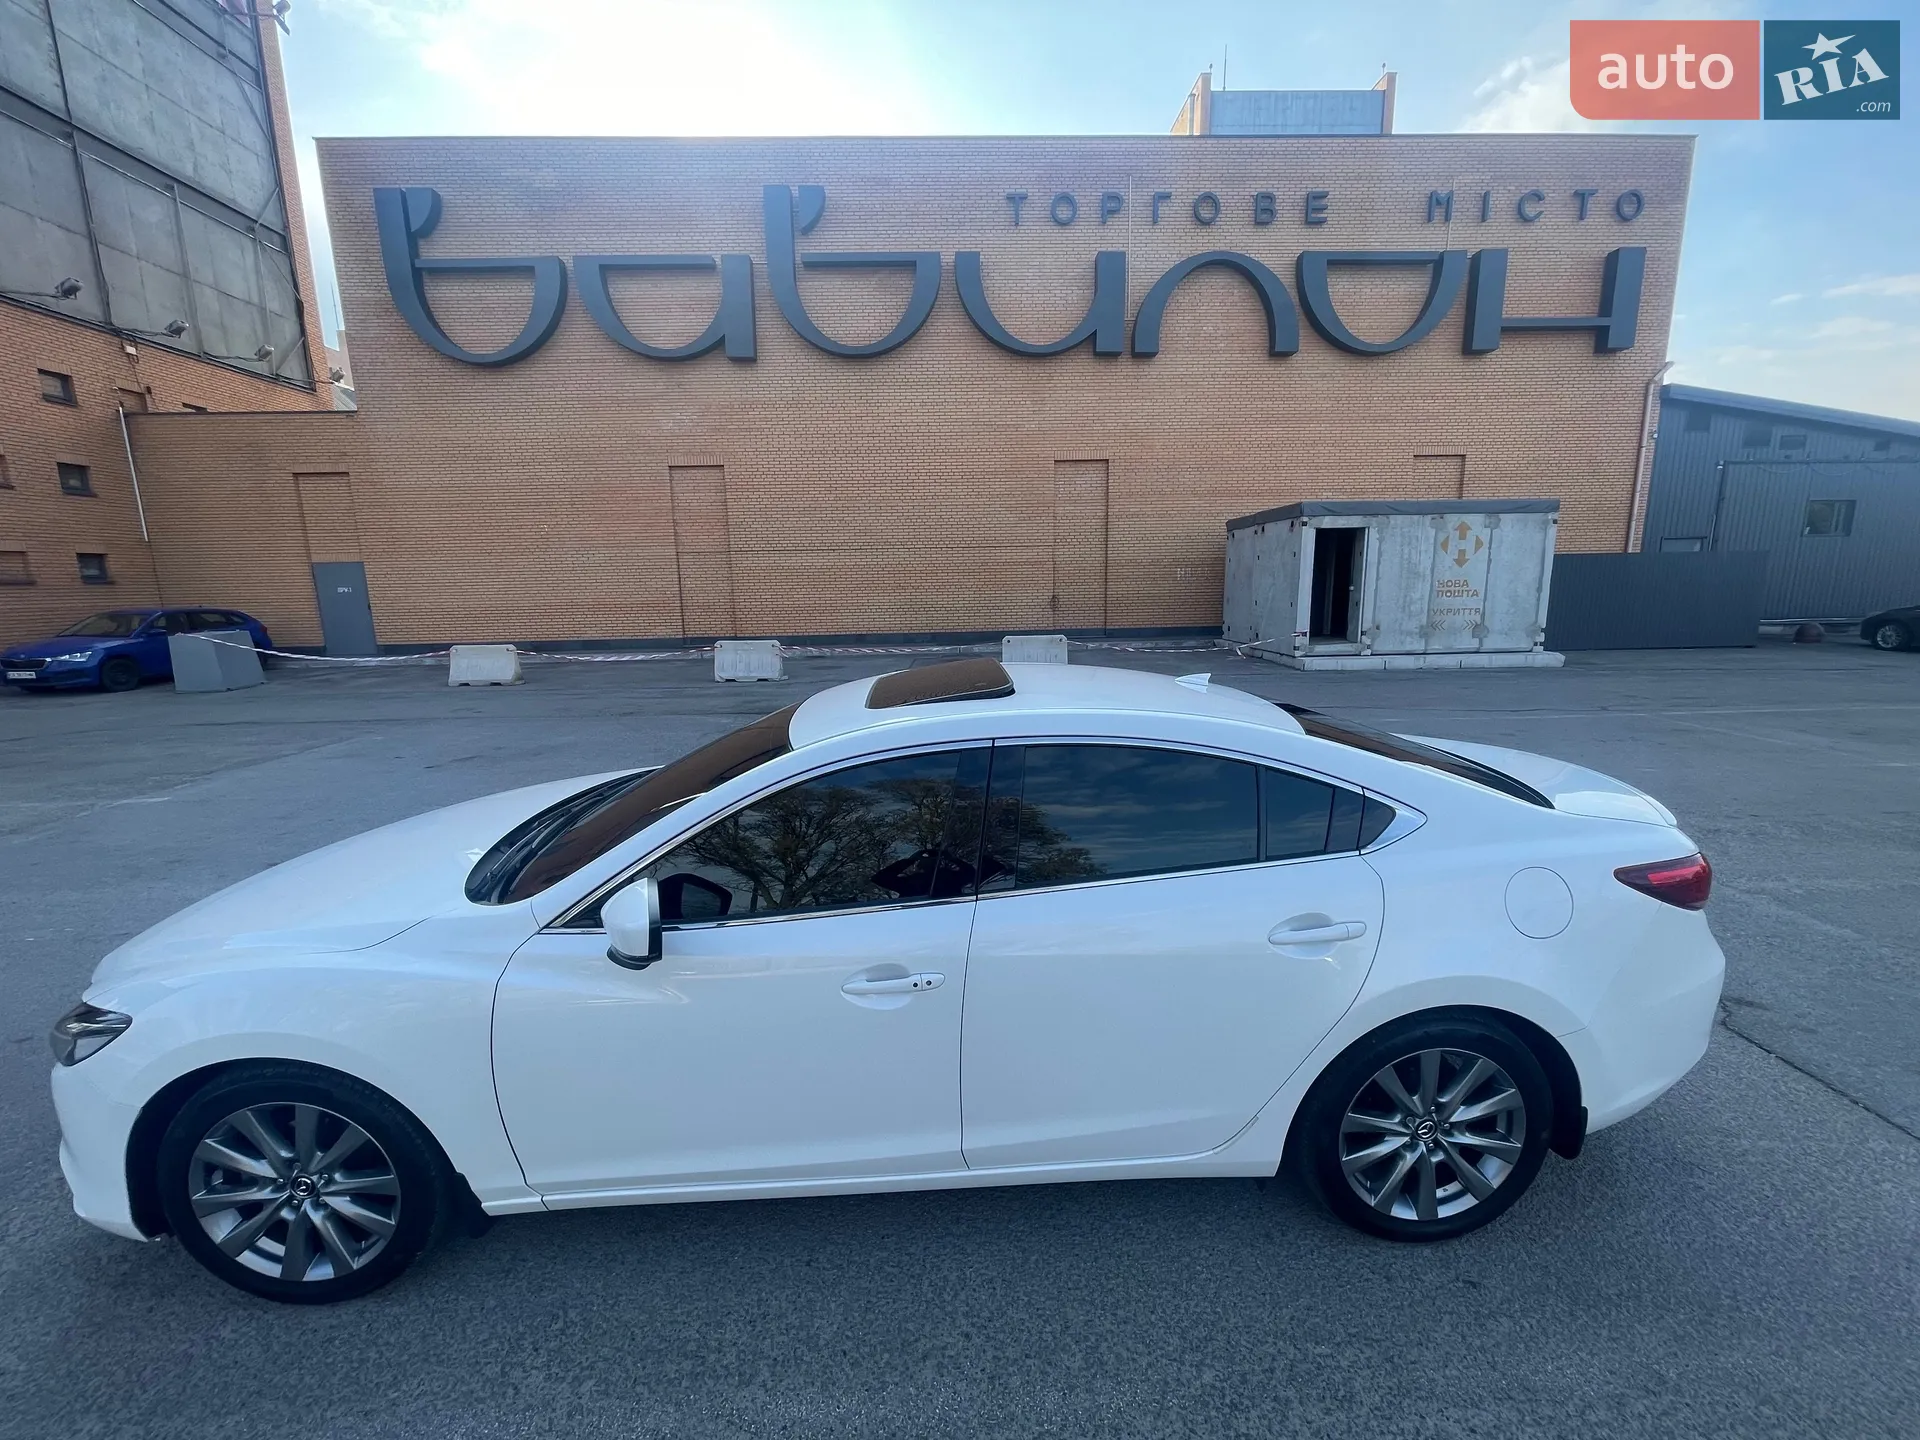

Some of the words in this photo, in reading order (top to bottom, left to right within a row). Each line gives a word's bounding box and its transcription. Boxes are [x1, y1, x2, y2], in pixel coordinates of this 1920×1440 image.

[1006, 190, 1330, 227] ТОРГОВЕ
[1427, 188, 1645, 223] МІСТО
[1436, 579, 1469, 588] НОВА
[1436, 589, 1479, 598] ПОШТА
[1432, 607, 1481, 616] УКРИТТЯ
